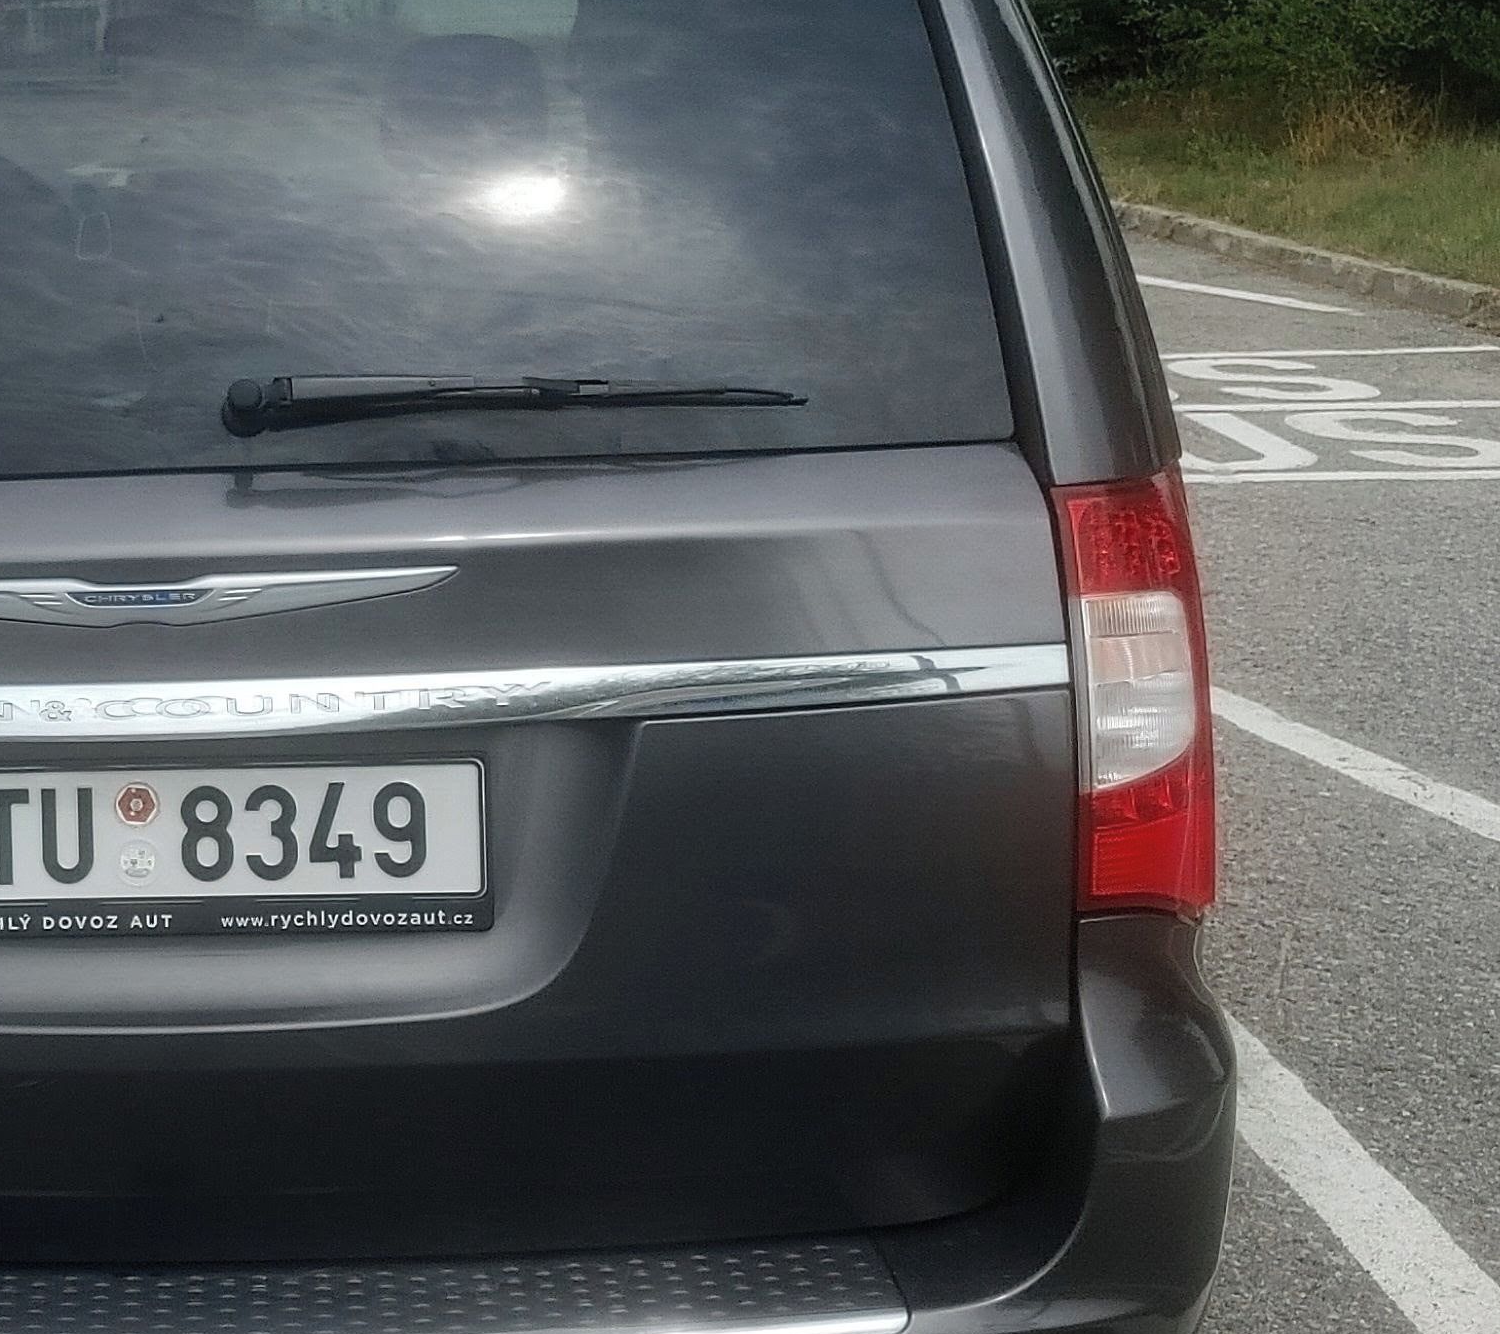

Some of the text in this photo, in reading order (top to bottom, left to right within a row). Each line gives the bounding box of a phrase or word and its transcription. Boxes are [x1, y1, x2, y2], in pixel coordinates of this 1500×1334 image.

[84, 593, 197, 604] CHRYSLER
[179, 780, 427, 882] 8349
[42, 915, 118, 931] DOVOZ
[130, 913, 173, 930] AUT
[220, 909, 474, 930] www.rychlydovozaut.cz
